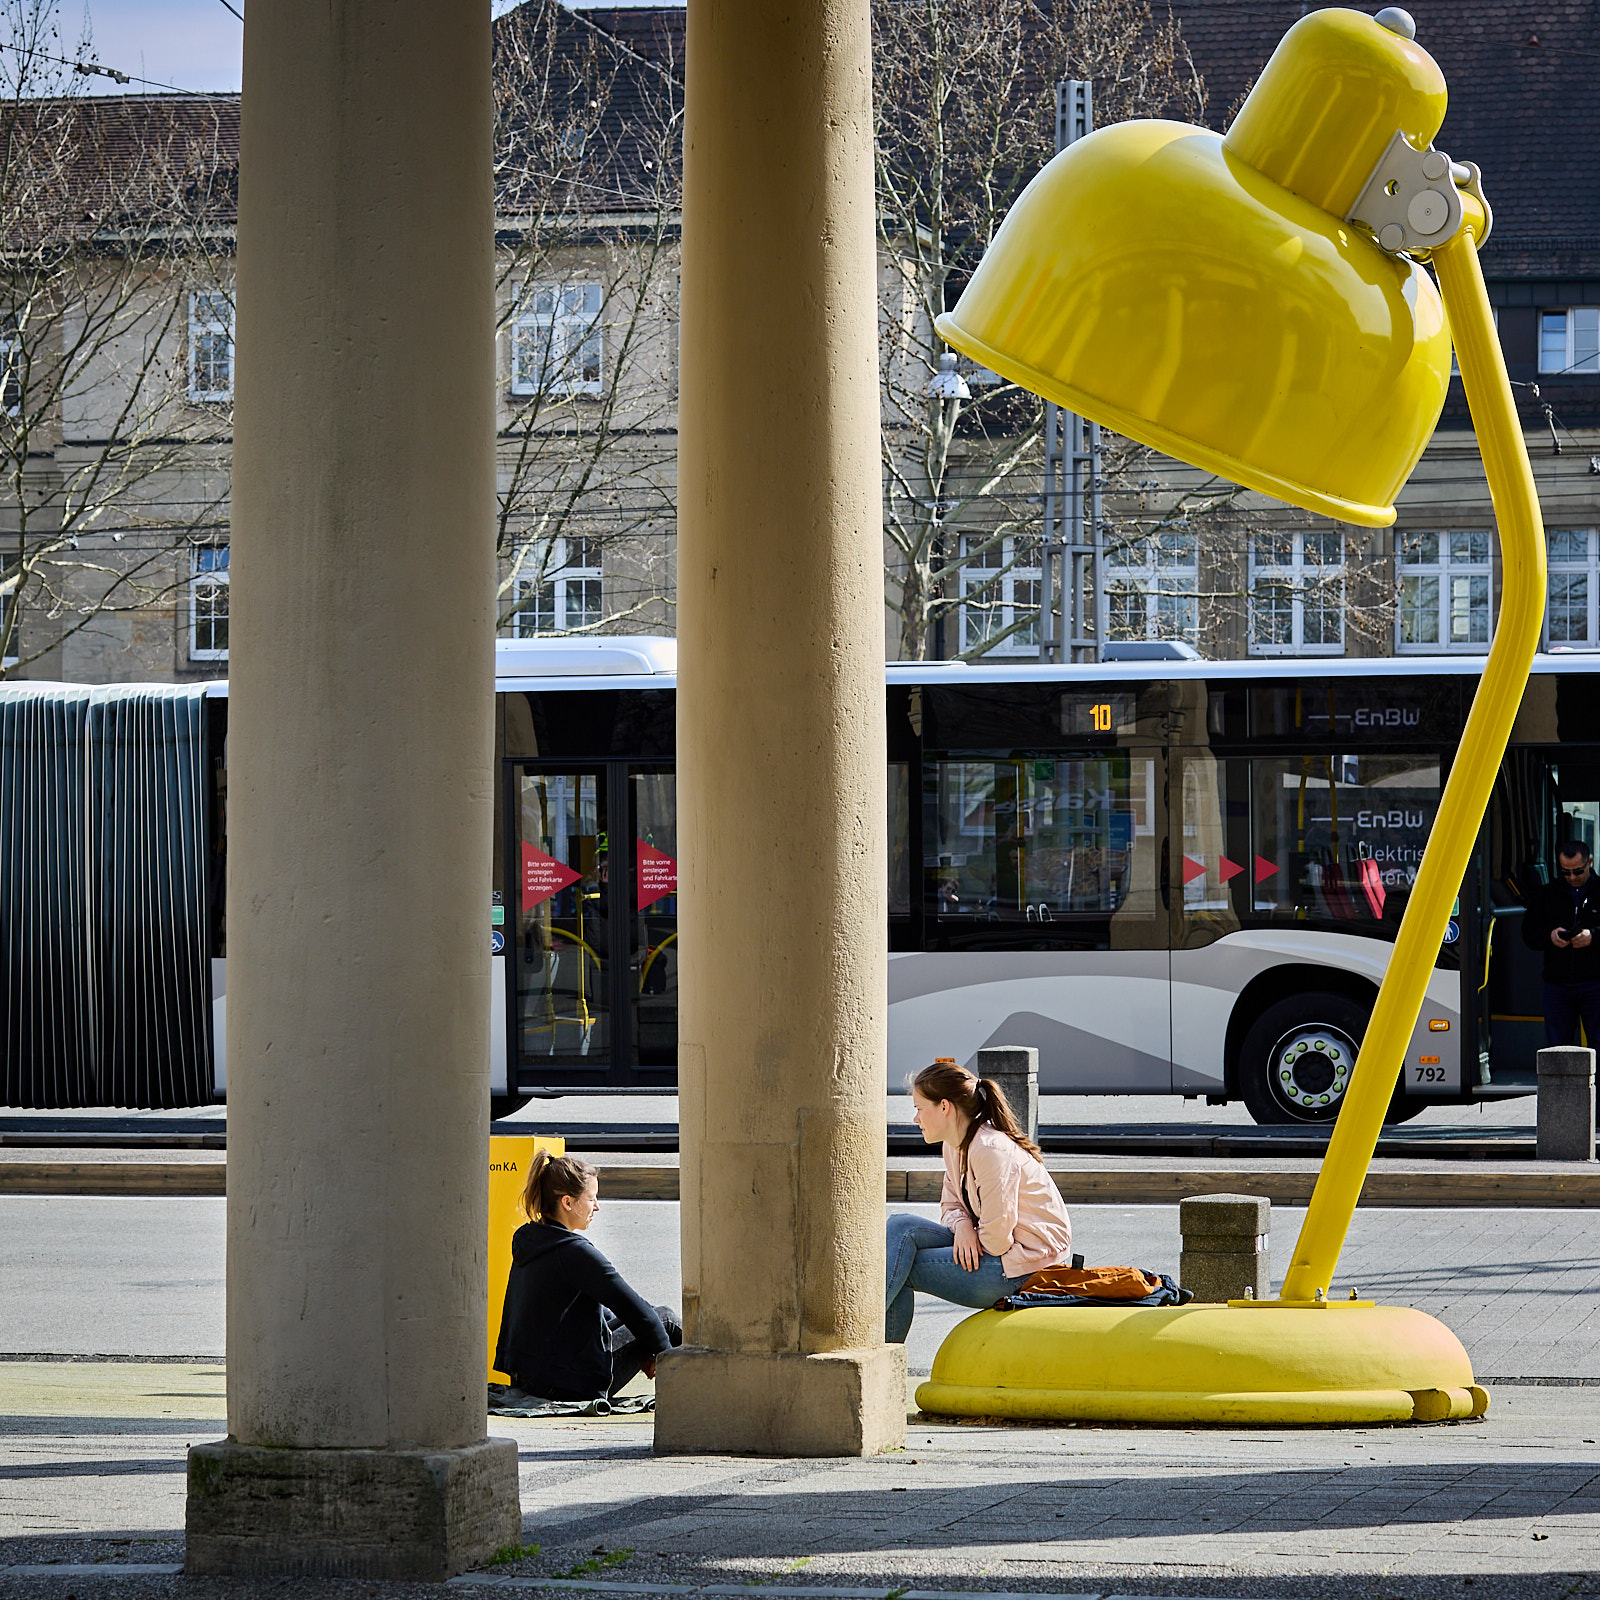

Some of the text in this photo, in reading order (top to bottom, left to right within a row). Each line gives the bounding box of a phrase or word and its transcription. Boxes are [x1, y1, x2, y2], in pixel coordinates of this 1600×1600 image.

[1089, 704, 1111, 730] 10
[1355, 708, 1421, 726] EnBW
[1357, 810, 1423, 828] EnBW
[1361, 844, 1425, 861] lektris
[1415, 1067, 1446, 1082] 792
